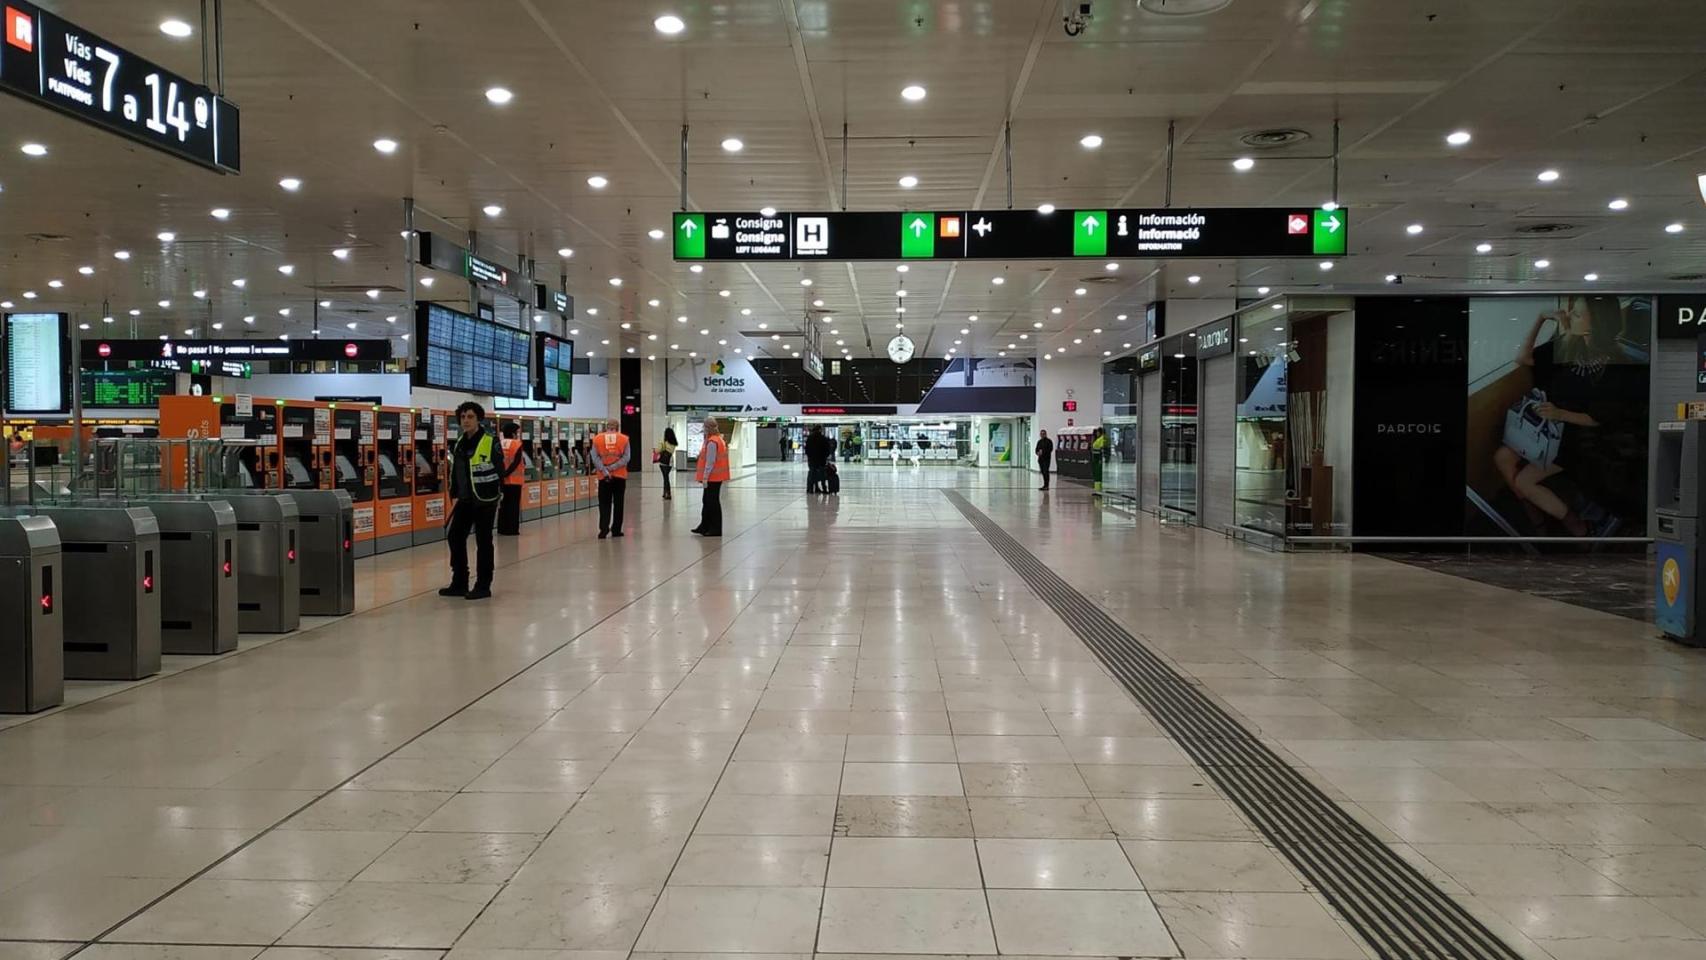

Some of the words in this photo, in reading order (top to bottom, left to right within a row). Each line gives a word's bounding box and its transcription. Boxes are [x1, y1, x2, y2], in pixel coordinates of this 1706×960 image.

[65, 33, 91, 61] Vías
[64, 58, 92, 86] Vies
[95, 47, 119, 112] 7
[123, 94, 137, 122] a
[145, 73, 190, 142] 14
[735, 217, 783, 231] Consigna
[1139, 213, 1205, 225] Información
[735, 231, 785, 245] Consigna
[1138, 227, 1200, 240] Informació
[735, 245, 750, 254] LEFT
[751, 245, 781, 254] LUGGAGE
[176, 345, 187, 354] No
[704, 376, 745, 387] tiendas
